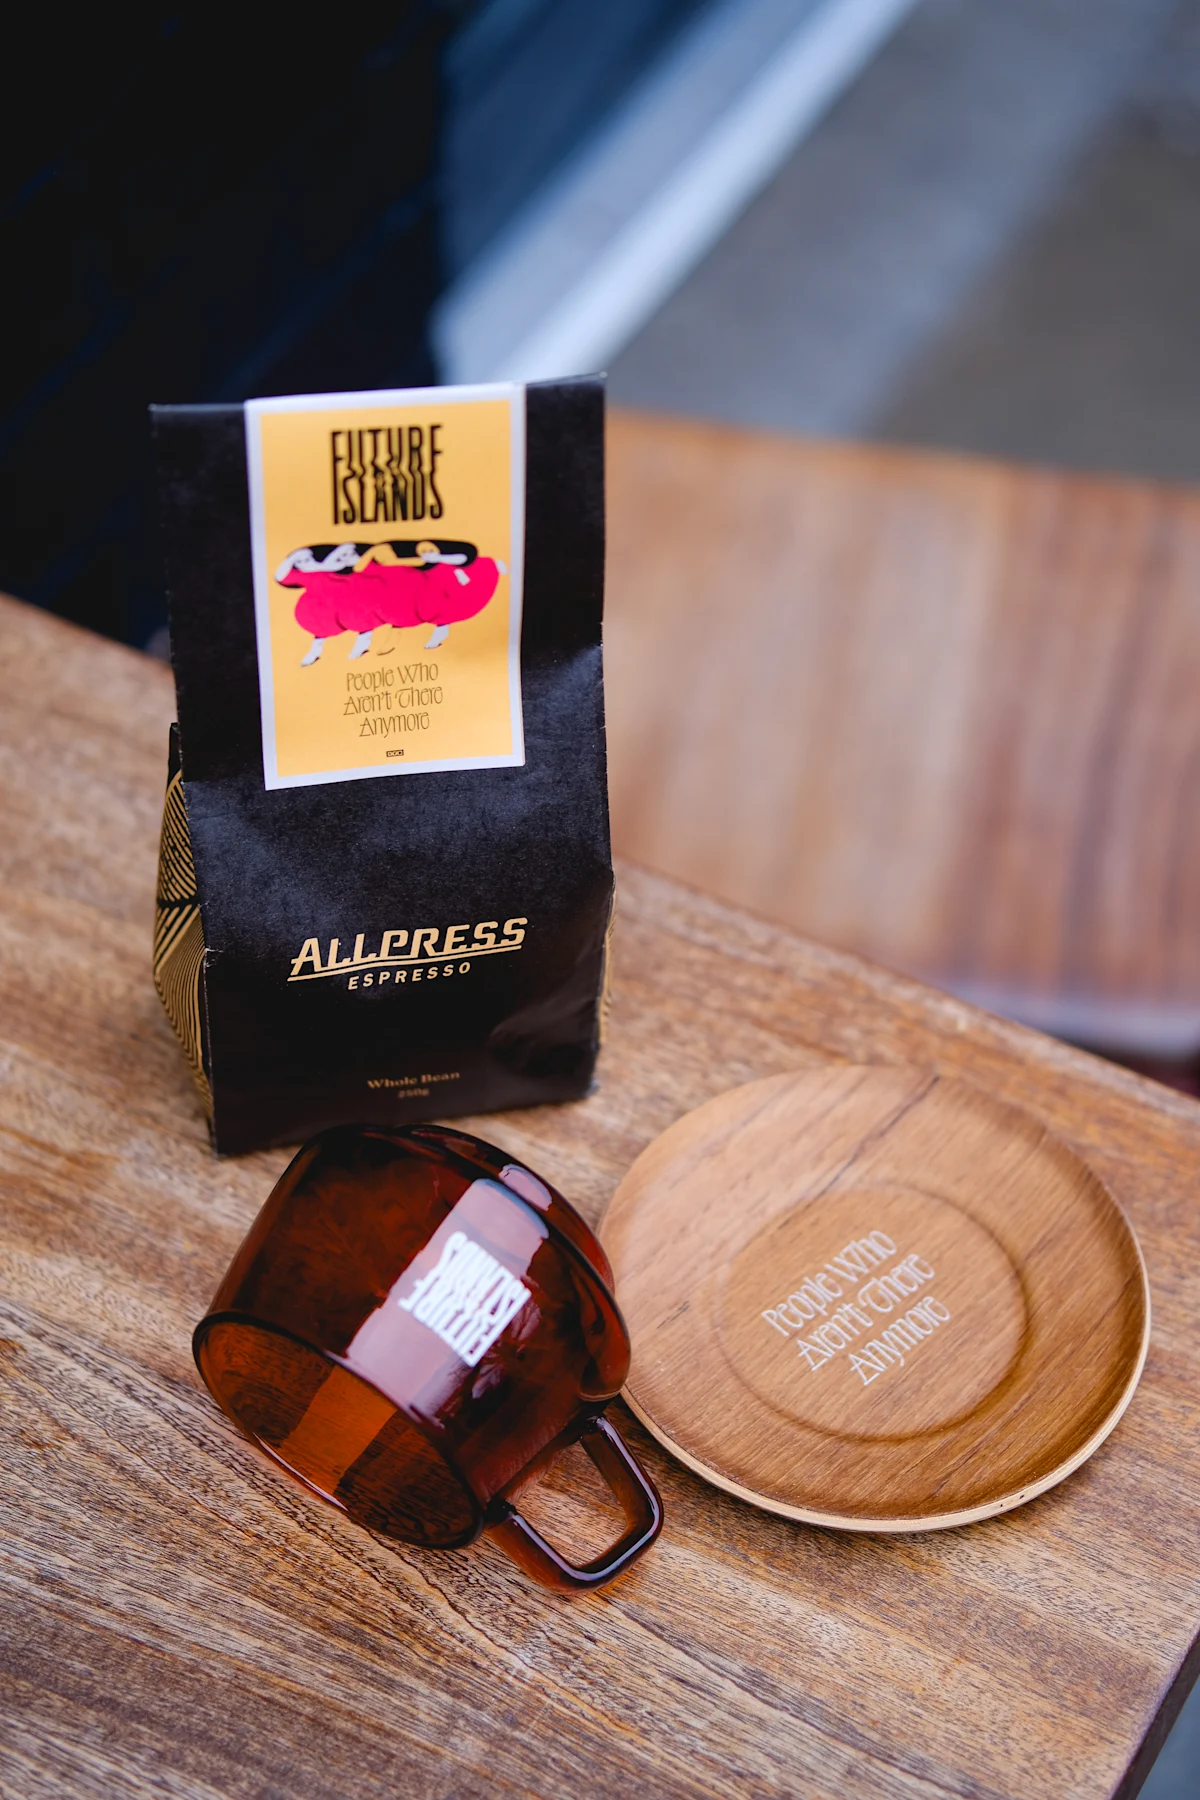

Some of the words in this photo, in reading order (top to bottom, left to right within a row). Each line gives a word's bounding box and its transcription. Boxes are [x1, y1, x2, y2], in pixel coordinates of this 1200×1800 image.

[331, 424, 443, 475] FUTURE
[333, 470, 444, 525] ISLANDS
[343, 691, 393, 715] Aren't
[395, 686, 443, 708] There
[346, 667, 395, 692] People
[397, 662, 438, 684] Who
[359, 712, 430, 738] Anymore
[288, 917, 529, 979] ALLPRESS
[347, 961, 471, 990] ESPRESSO
[367, 1077, 418, 1089] Whole
[421, 1072, 460, 1083] Bean
[761, 1273, 843, 1337] People
[824, 1230, 897, 1283] Who
[796, 1303, 874, 1371] Aren't
[858, 1253, 935, 1313] There
[849, 1296, 950, 1386] Anymore
